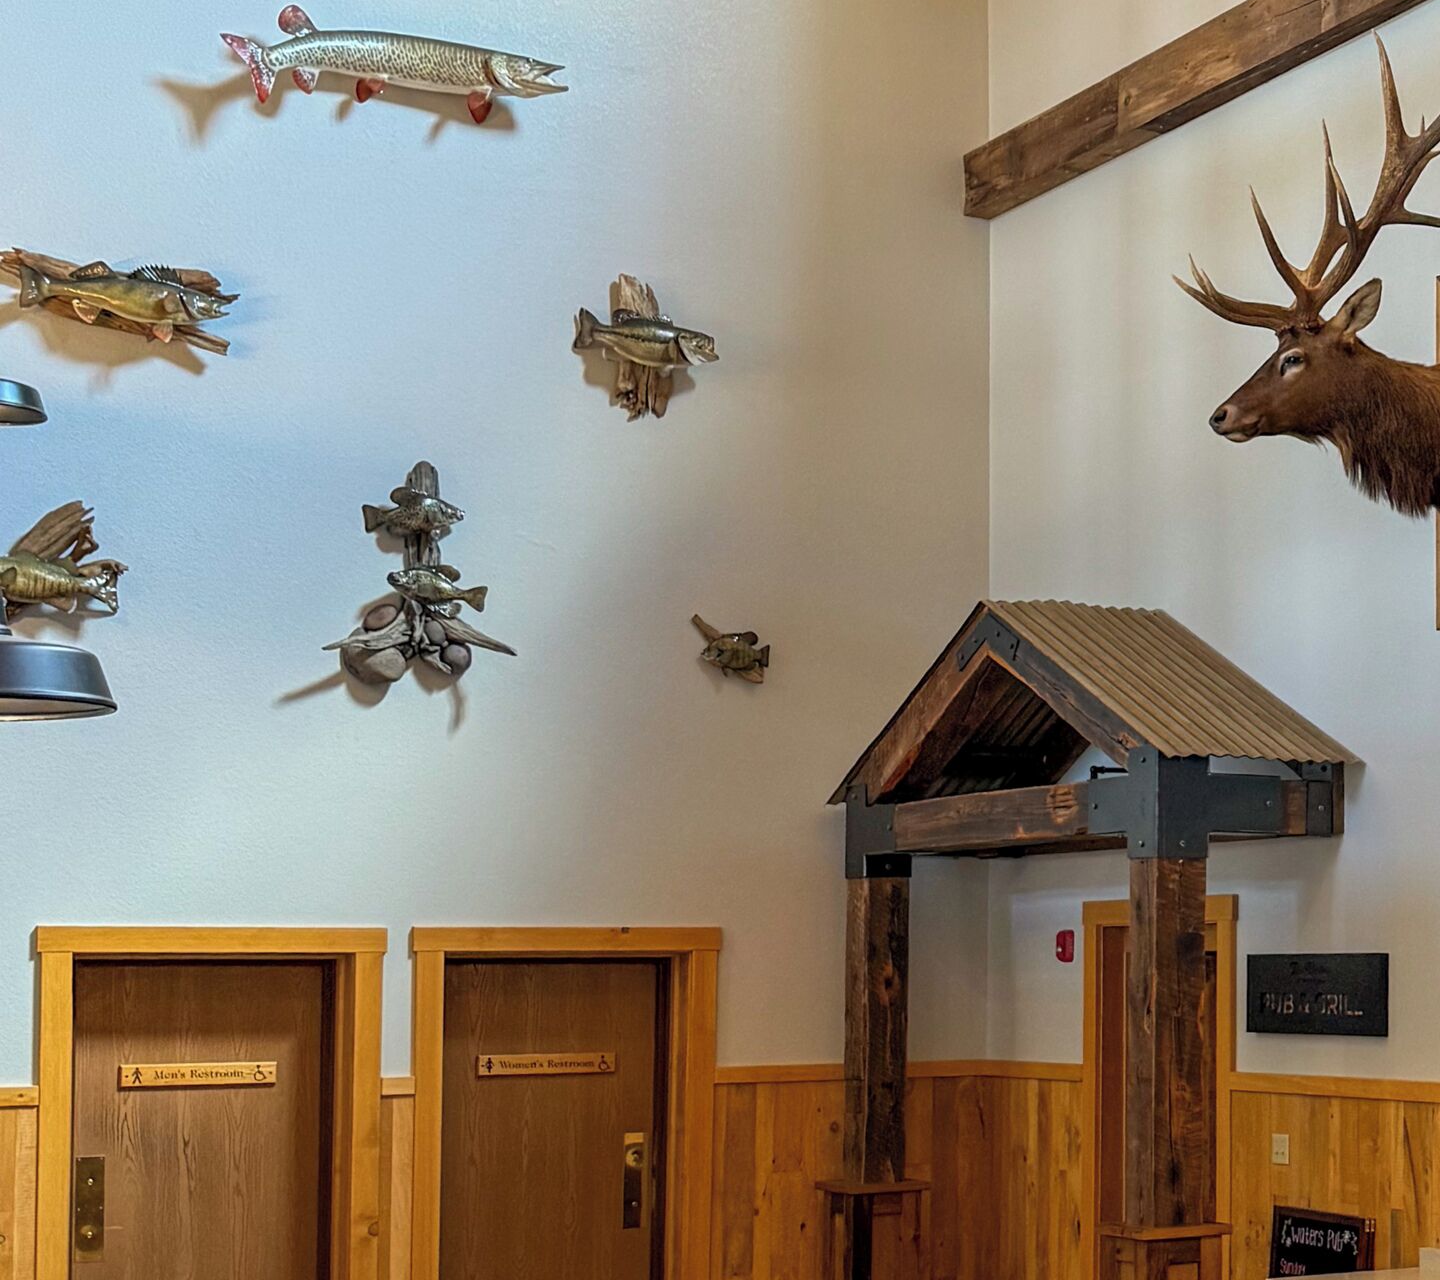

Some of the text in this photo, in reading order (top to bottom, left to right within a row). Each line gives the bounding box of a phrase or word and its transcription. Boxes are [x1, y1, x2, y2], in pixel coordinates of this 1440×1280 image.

[500, 1059, 594, 1069] Women's Restroom
[153, 1069, 245, 1080] Men's Restroom
